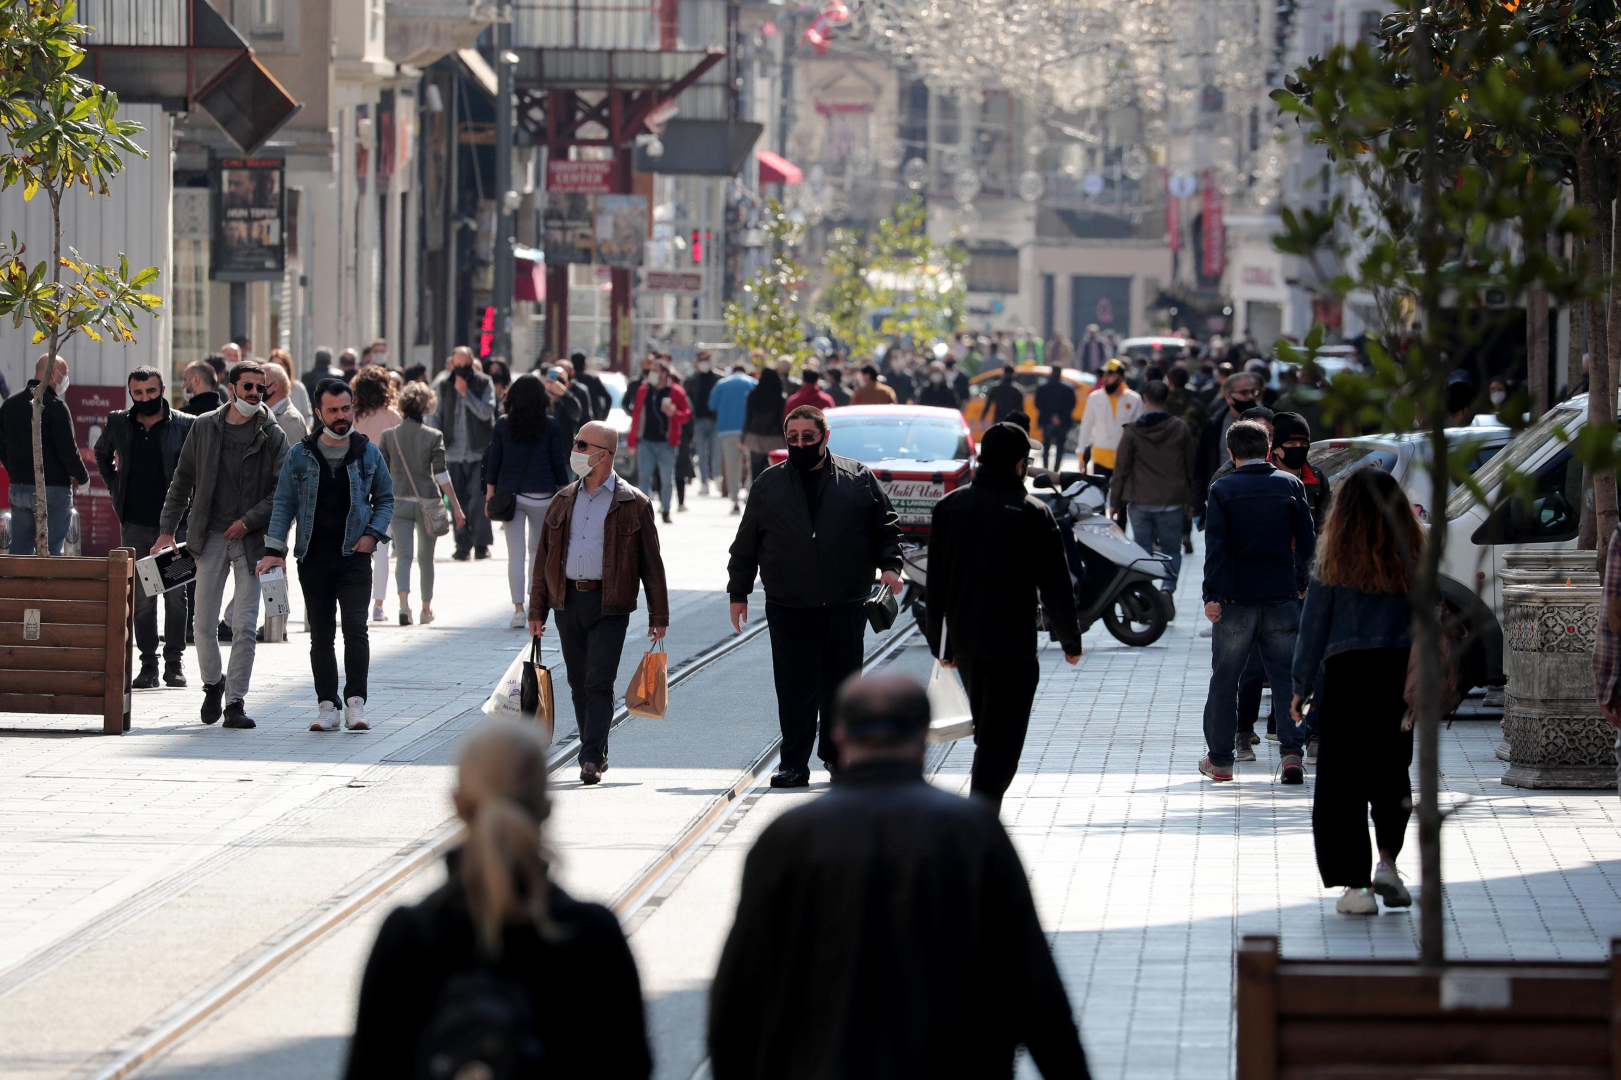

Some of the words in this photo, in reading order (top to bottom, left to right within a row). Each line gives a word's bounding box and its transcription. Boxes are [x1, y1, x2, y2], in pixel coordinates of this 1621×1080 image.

[555, 173, 602, 184] CENTER
[82, 399, 109, 407] TUDORS
[916, 484, 943, 498] Usta
